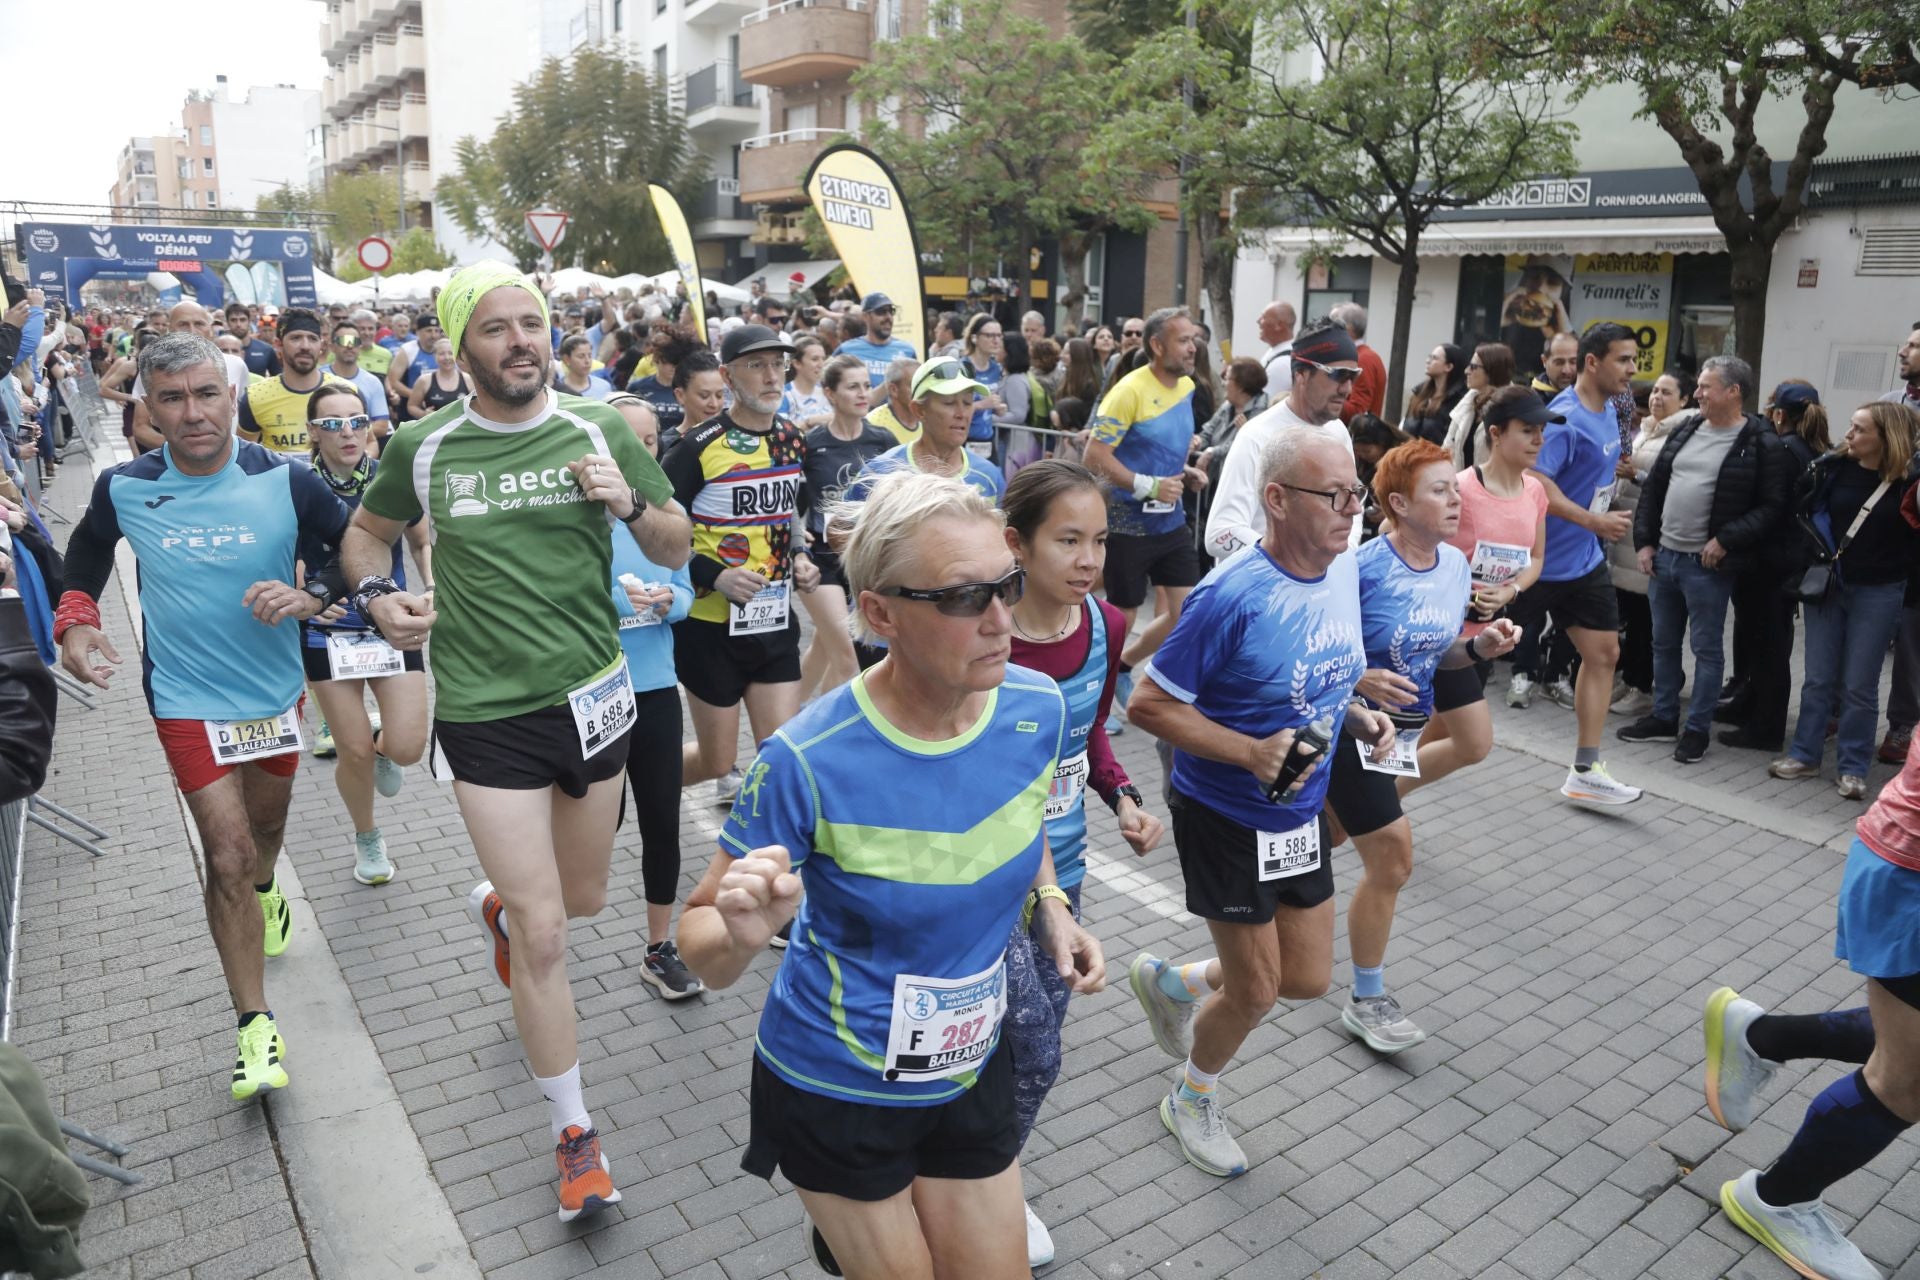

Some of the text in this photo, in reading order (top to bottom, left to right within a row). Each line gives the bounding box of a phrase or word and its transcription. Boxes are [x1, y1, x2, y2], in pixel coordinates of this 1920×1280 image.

[136, 232, 212, 244] VOLTA A PEU
[154, 243, 198, 256] DÉNIA
[1586, 260, 1660, 273] APERTURA
[1582, 283, 1661, 301] Fanneli's
[271, 433, 307, 447] BALE
[499, 466, 576, 494] aecc
[501, 497, 524, 511] en
[167, 525, 249, 535] CAMPING
[162, 533, 257, 548] PEPE
[752, 606, 773, 620] 787
[1410, 631, 1449, 642] CIRCUIT
[1328, 667, 1353, 685] PEU
[587, 700, 623, 735] B 688
[219, 721, 275, 743] D 1241
[237, 738, 281, 752] BALEARIA
[1045, 805, 1063, 815] NIA
[1269, 836, 1306, 857] E 588
[1280, 853, 1311, 868] BALEARIA
[940, 987, 975, 1001] CIRCUIT
[945, 989, 991, 1009] MARINA ALTA
[953, 1002, 984, 1017] MONICA
[909, 1014, 988, 1052] F 287
[928, 1039, 989, 1068] BALEARIA
